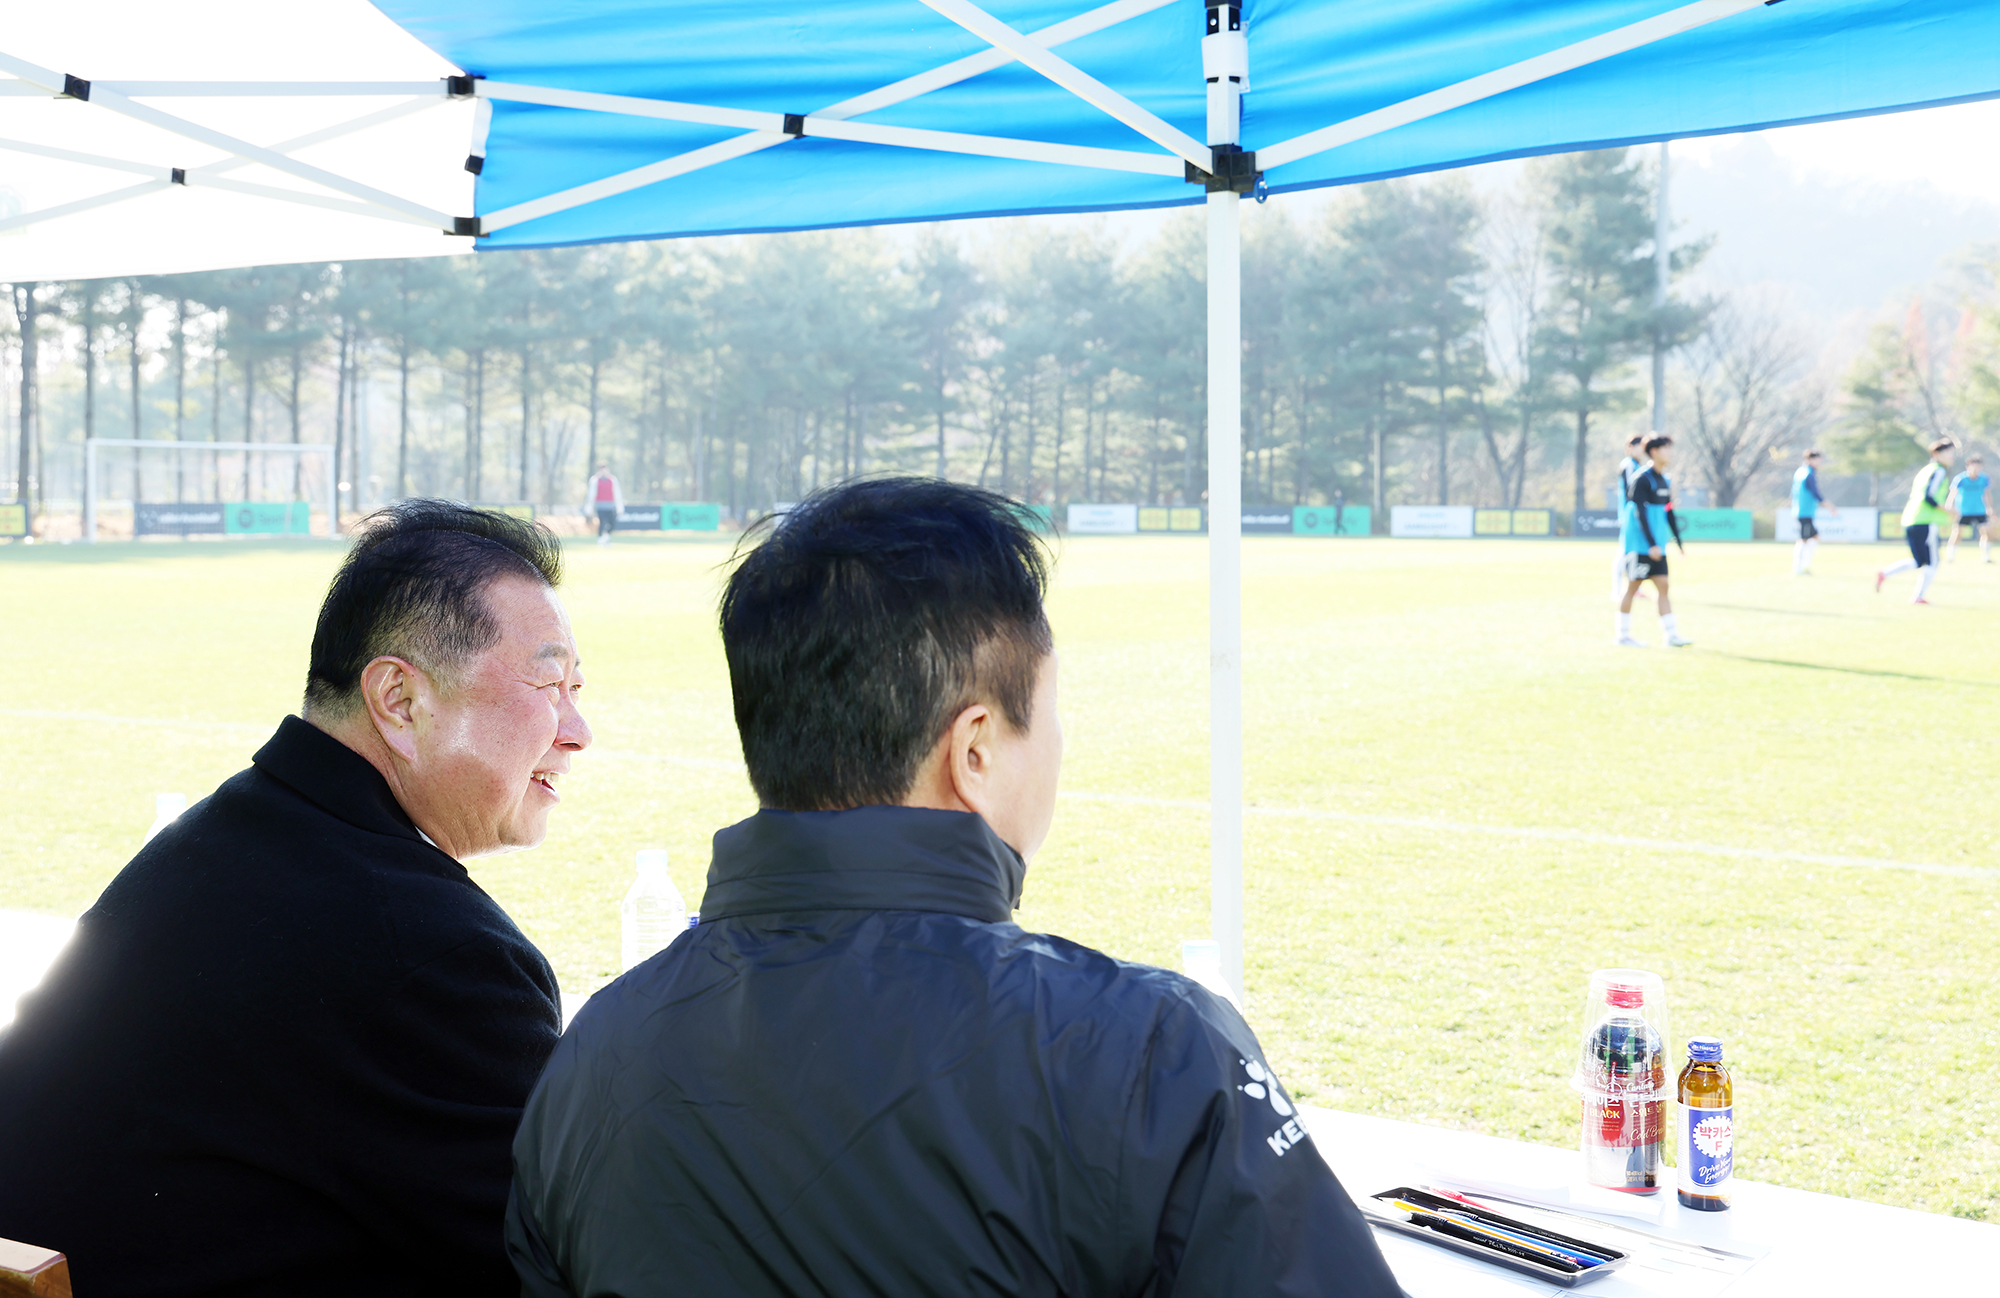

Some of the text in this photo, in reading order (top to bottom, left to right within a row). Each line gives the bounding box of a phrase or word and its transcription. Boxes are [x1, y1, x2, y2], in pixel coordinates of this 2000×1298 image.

[1589, 1107, 1621, 1119] BLACK
[1700, 1126, 1732, 1139] 박카스
[1715, 1140, 1723, 1151] F
[1698, 1164, 1721, 1177] Drive
